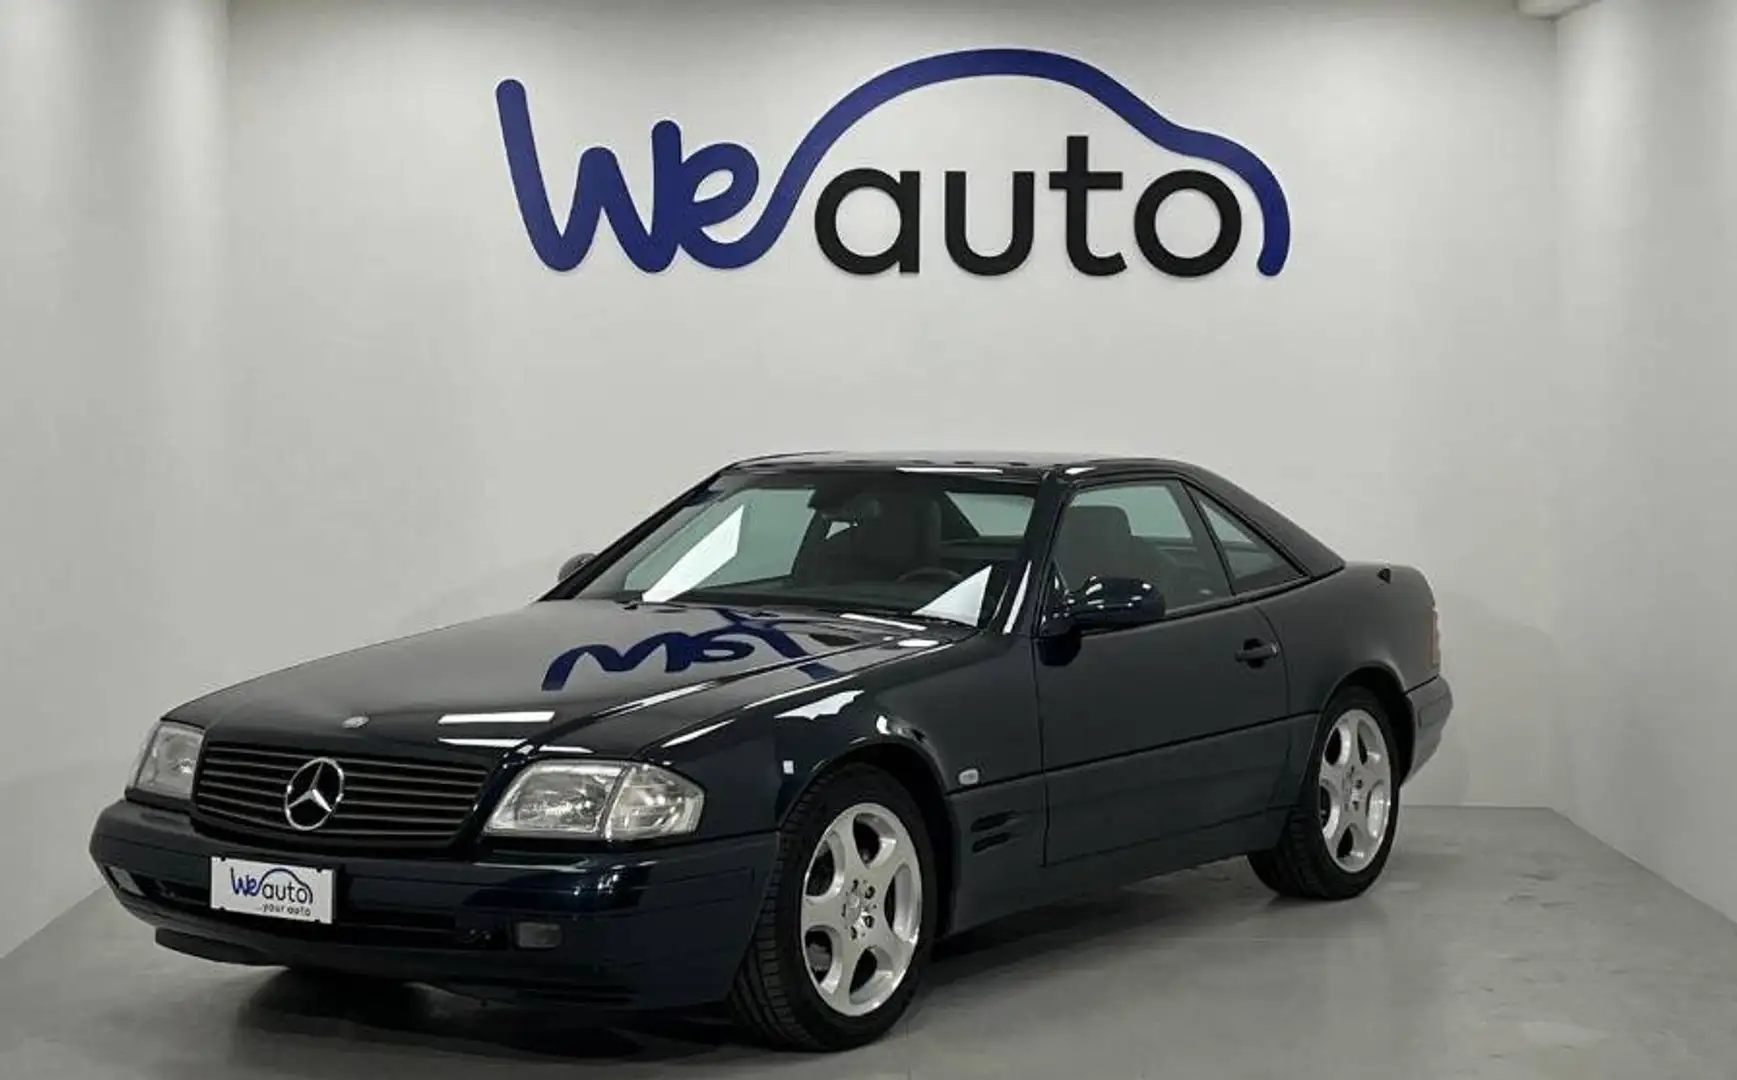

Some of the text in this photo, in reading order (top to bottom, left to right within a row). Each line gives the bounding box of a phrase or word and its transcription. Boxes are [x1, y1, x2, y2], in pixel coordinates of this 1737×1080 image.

[496, 79, 1242, 277] We auto
[230, 867, 308, 904] We auto
[287, 905, 311, 917] auto
